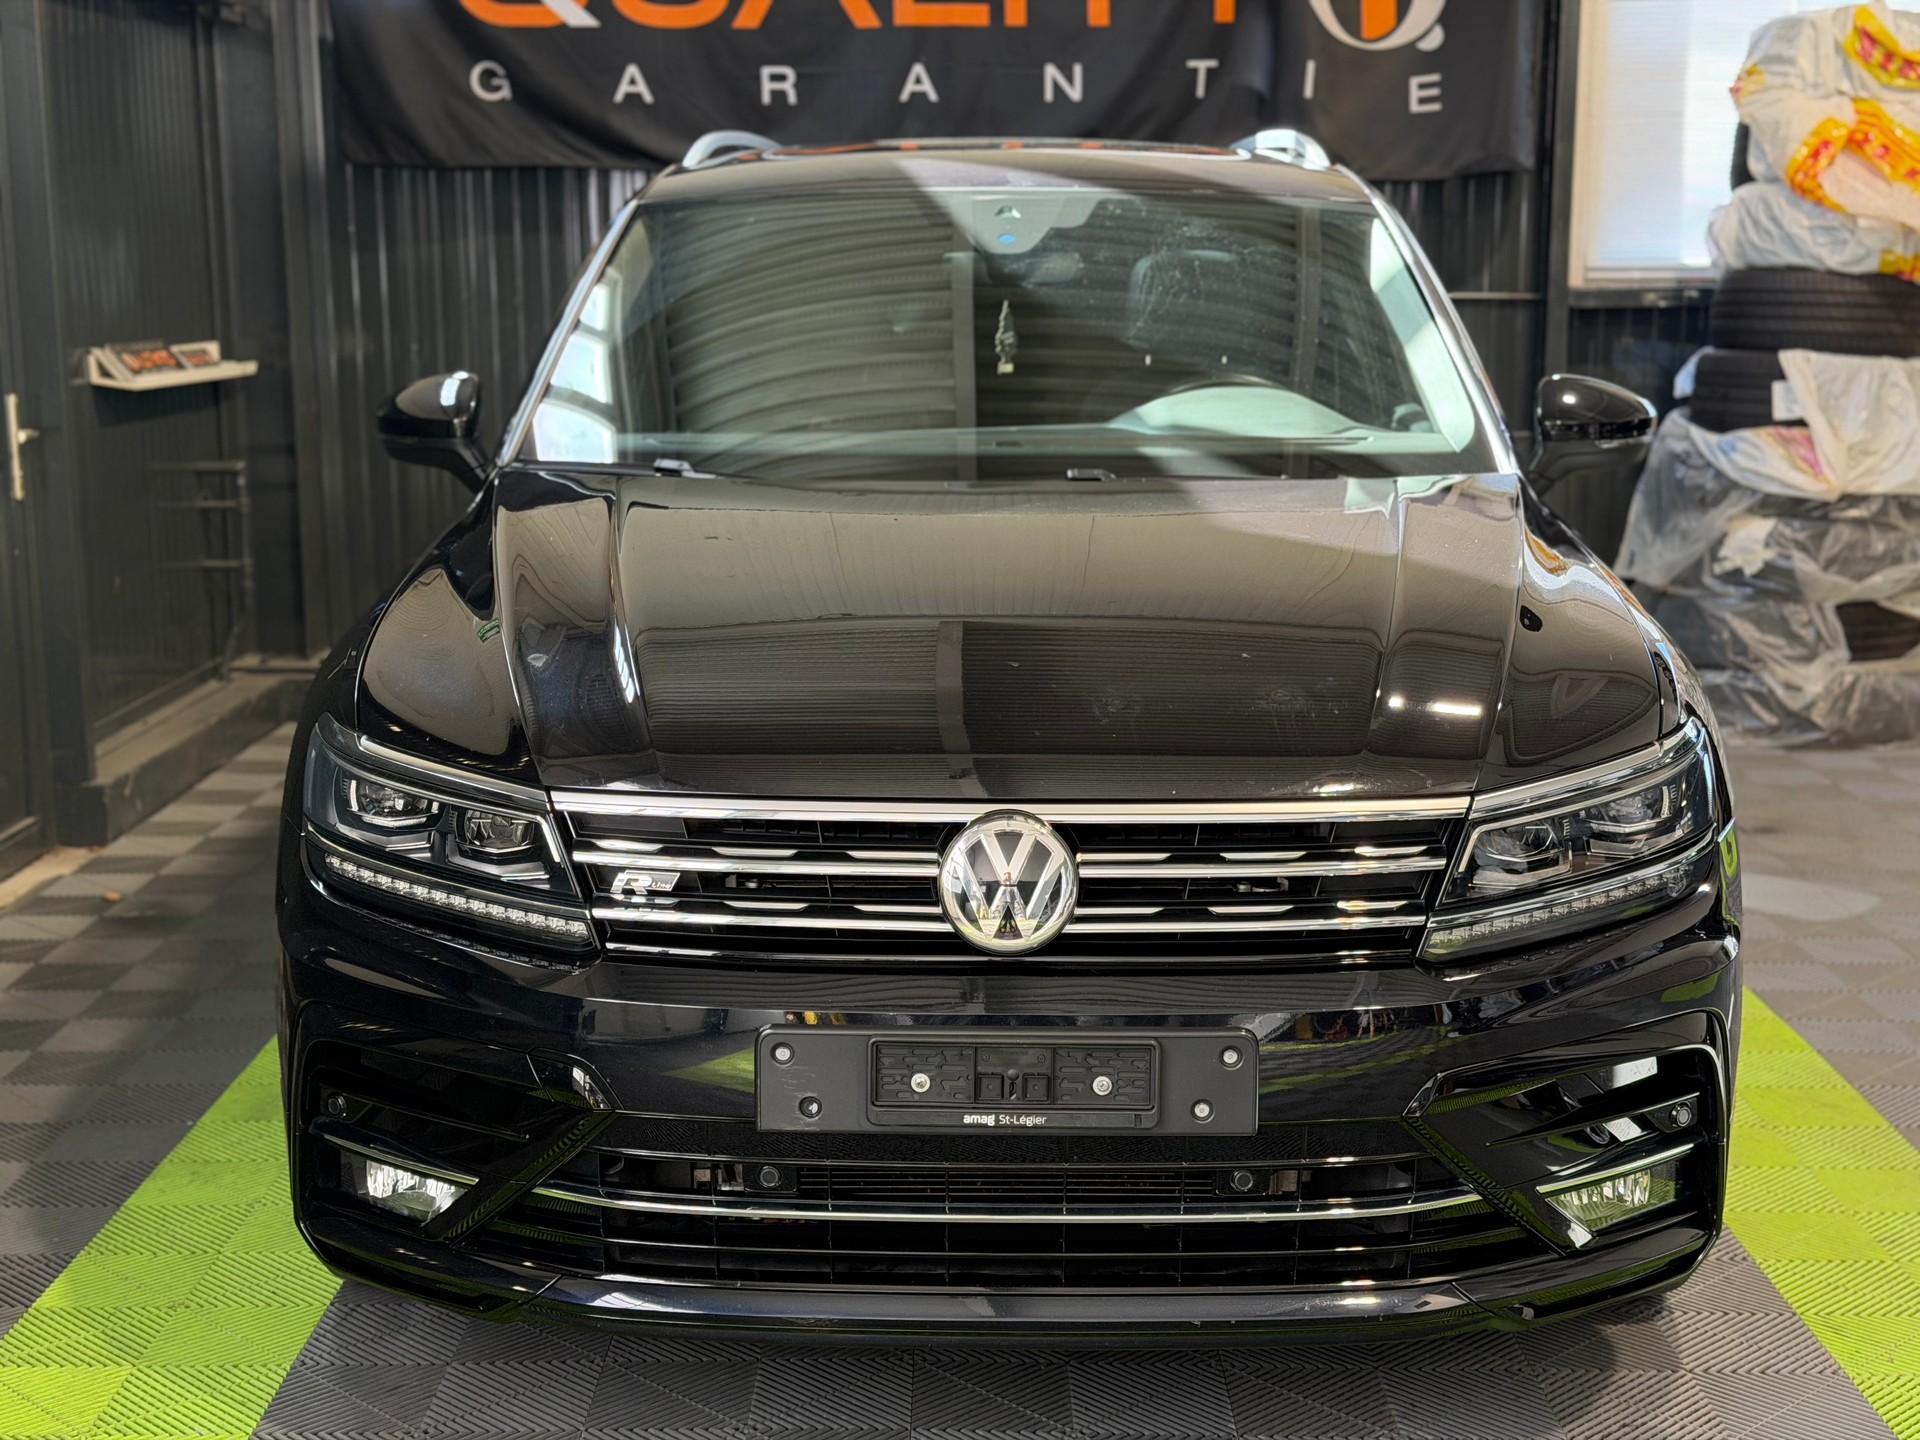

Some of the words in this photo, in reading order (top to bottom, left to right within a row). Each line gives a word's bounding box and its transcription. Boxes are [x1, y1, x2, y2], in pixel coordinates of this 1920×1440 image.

[469, 60, 1443, 114] GARANTIE
[963, 1114, 996, 1126] amag
[999, 1114, 1047, 1126] St-Légier
